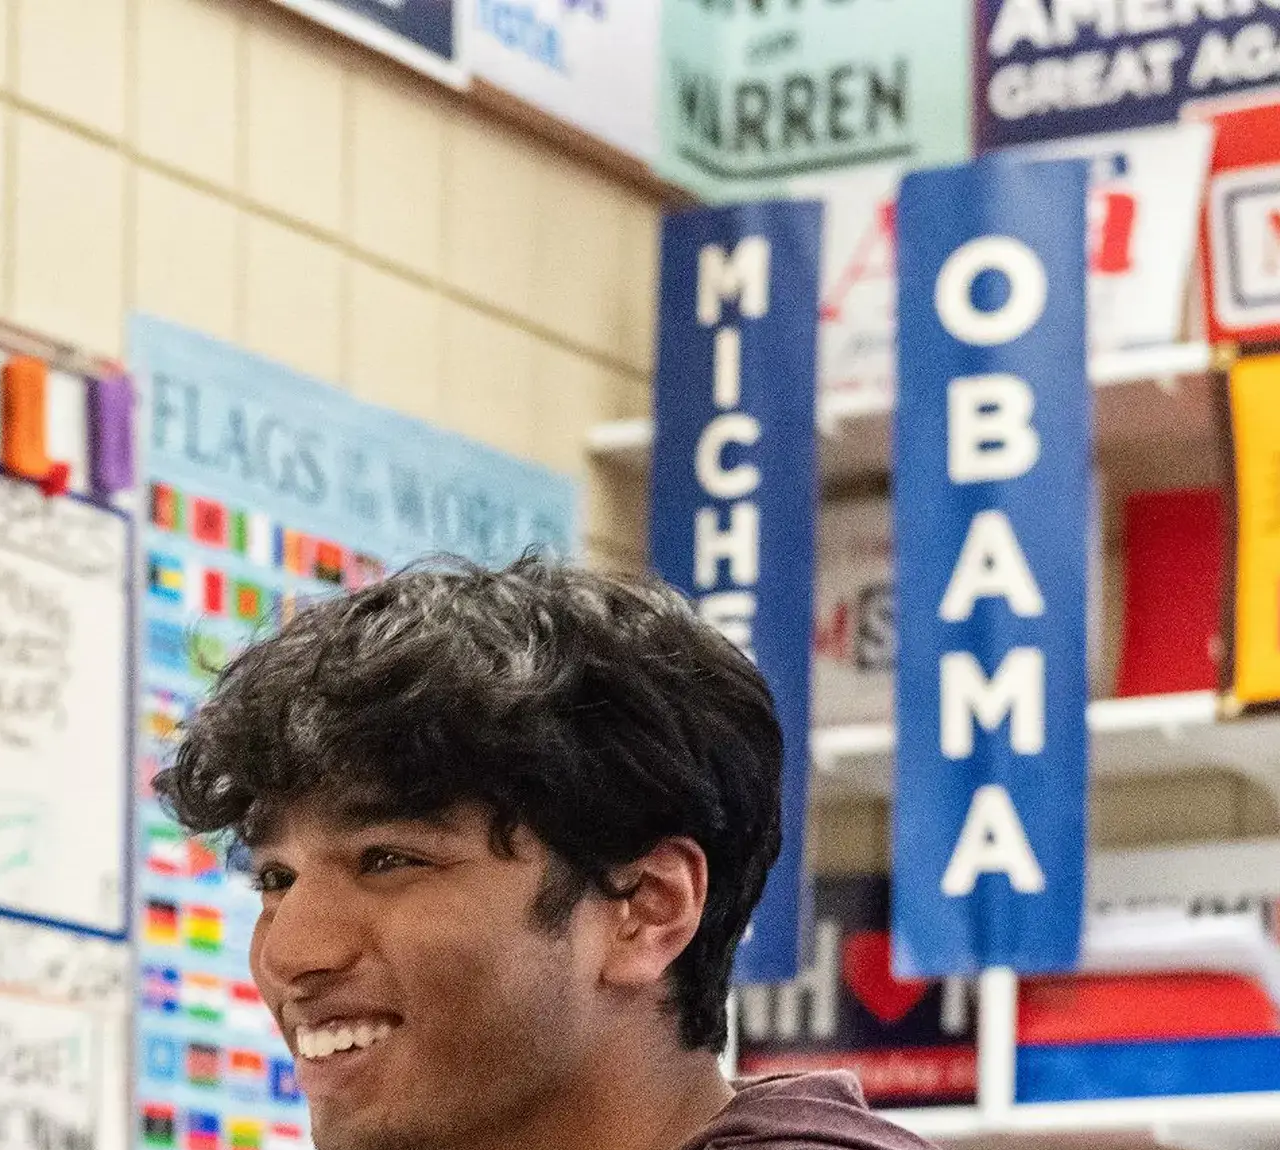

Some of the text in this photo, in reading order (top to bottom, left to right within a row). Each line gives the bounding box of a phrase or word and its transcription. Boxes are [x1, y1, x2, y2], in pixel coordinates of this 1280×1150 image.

[988, 37, 1180, 119] GREAT
[151, 370, 330, 505] FLAGS
[934, 235, 1050, 898] OBAMA
